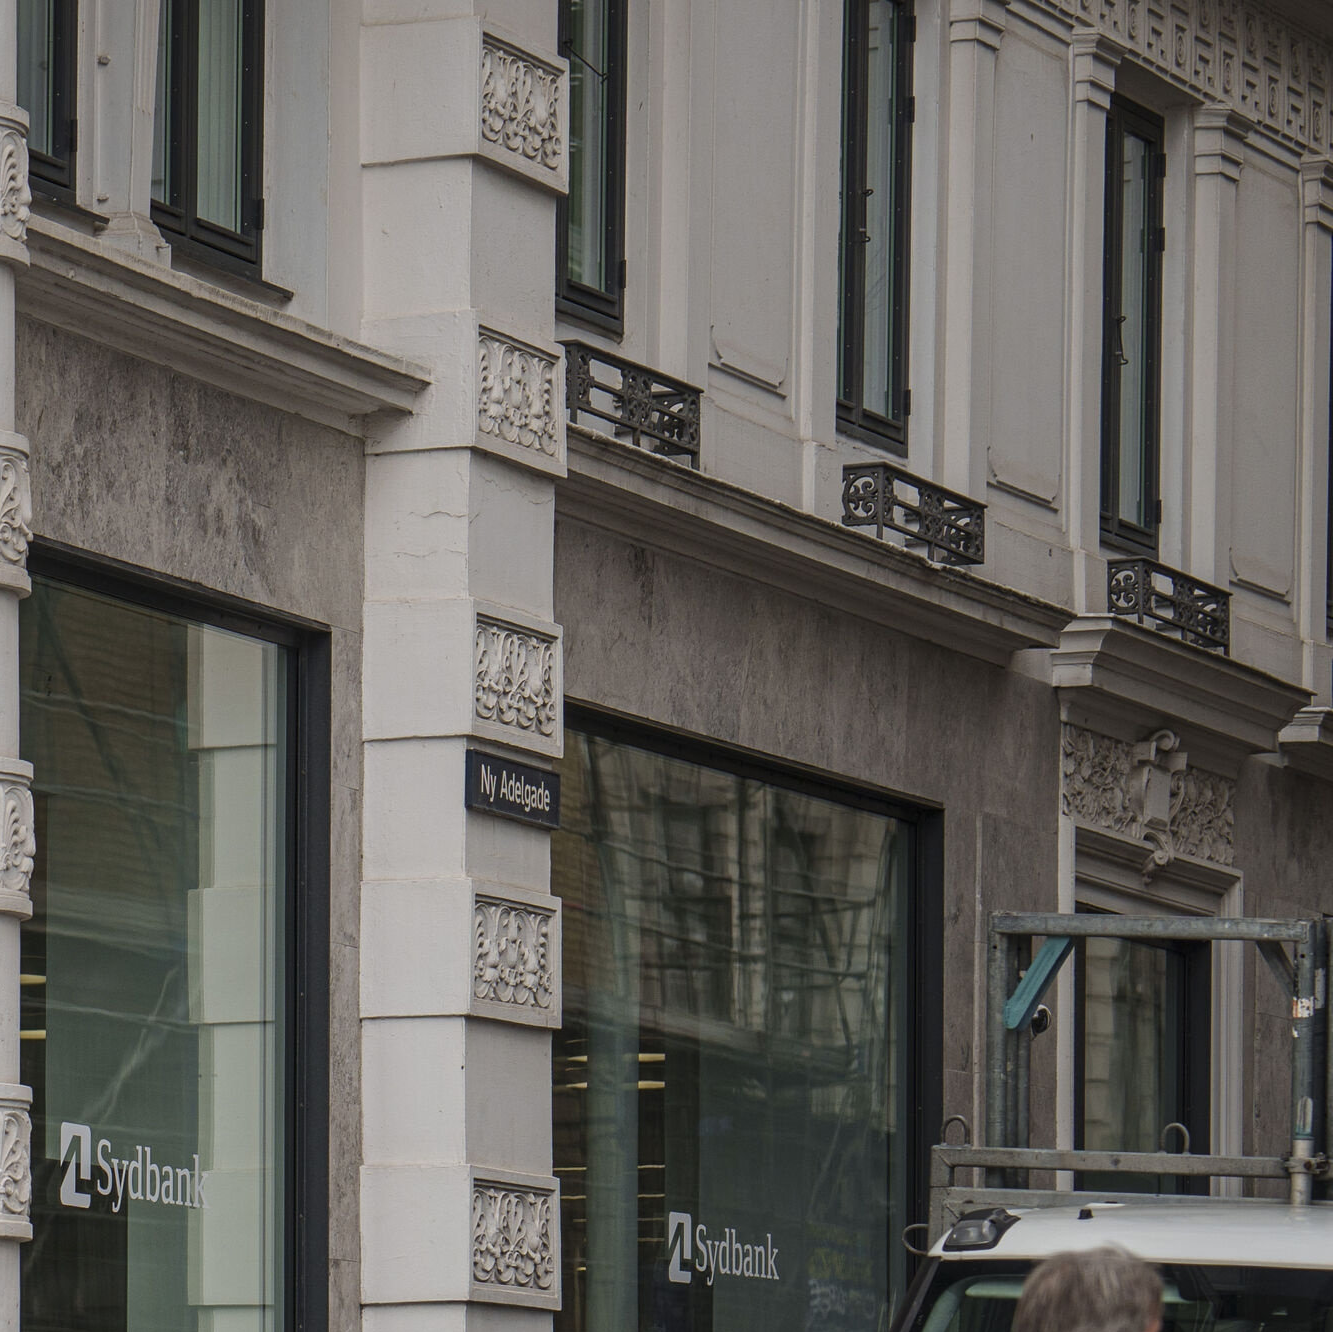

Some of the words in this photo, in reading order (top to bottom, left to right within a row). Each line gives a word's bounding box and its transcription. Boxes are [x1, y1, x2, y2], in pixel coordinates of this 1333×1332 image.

[480, 763, 497, 803] Ny
[499, 769, 551, 812] Adelgade
[97, 1138, 210, 1213] Sydbank
[695, 1223, 780, 1287] Sydbank
